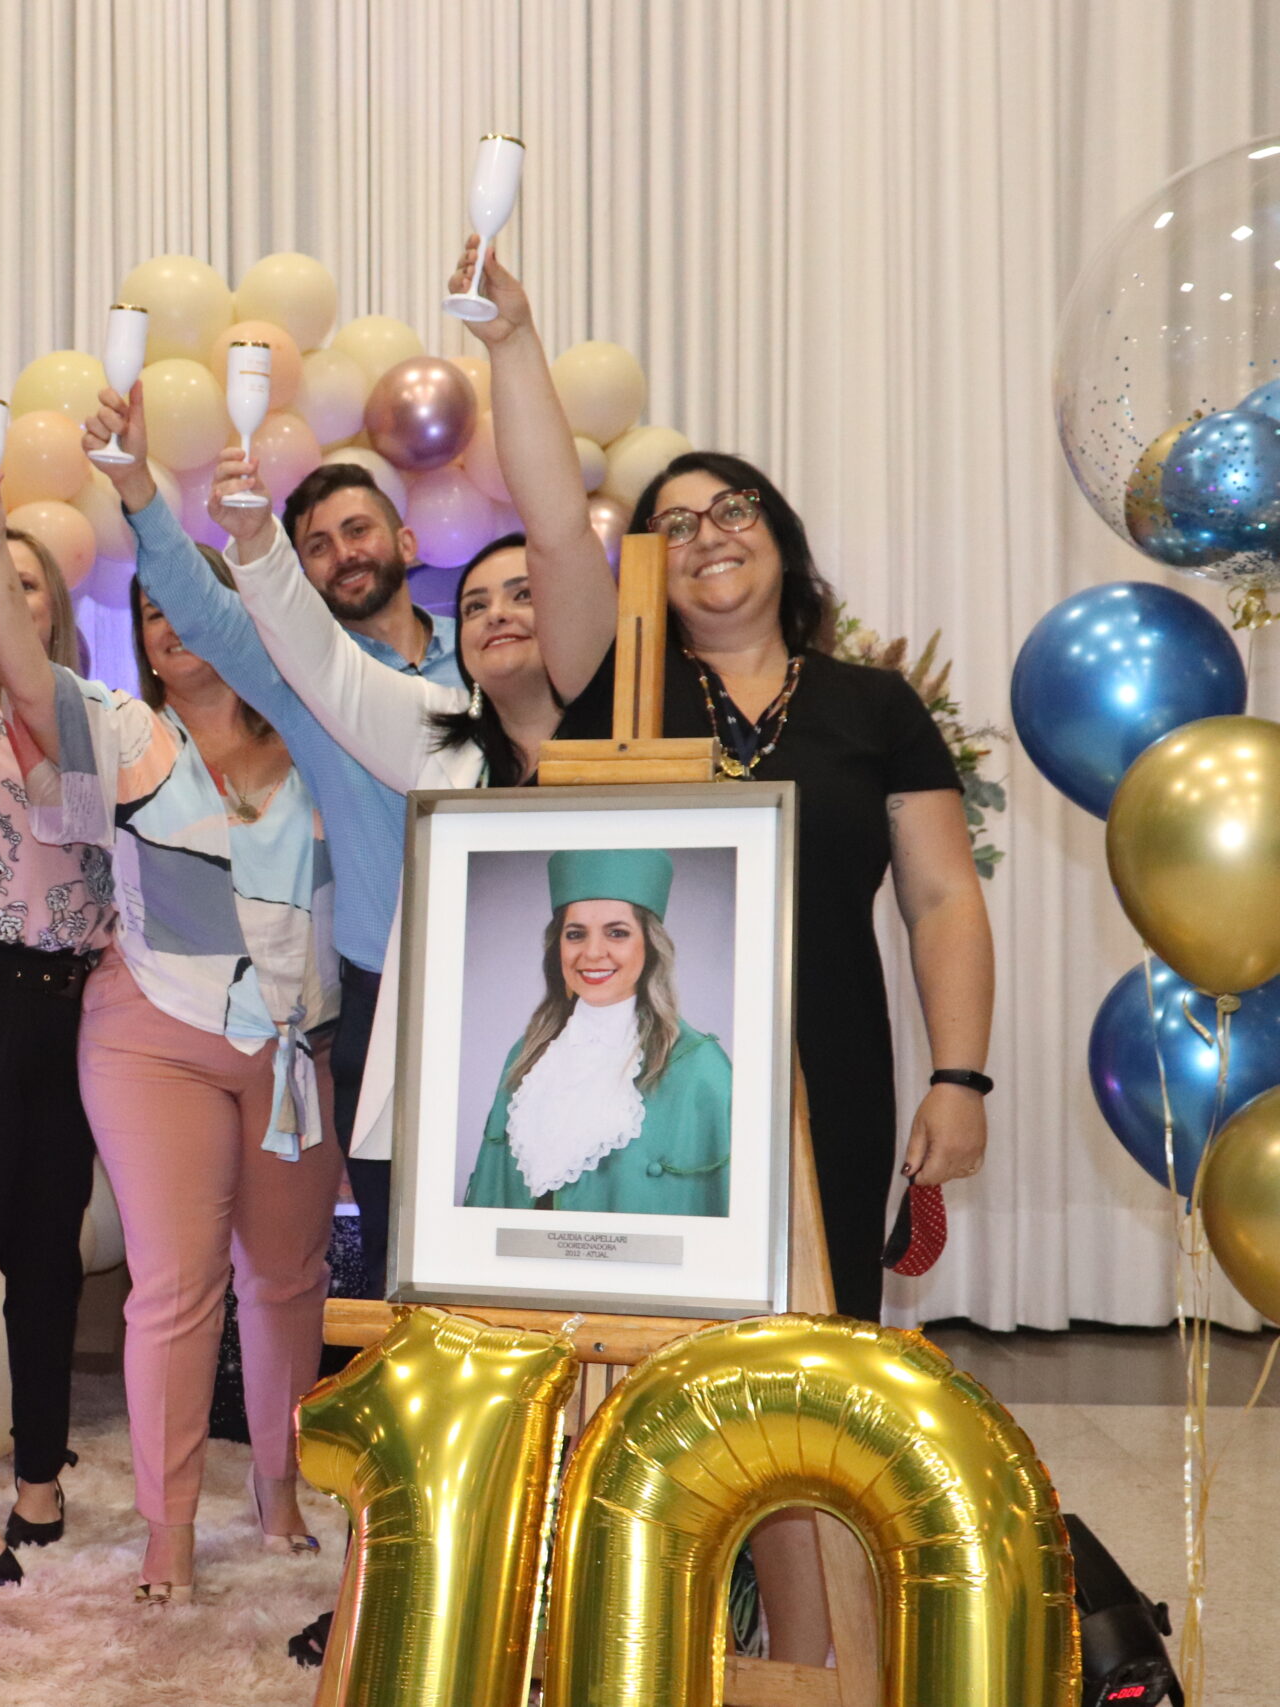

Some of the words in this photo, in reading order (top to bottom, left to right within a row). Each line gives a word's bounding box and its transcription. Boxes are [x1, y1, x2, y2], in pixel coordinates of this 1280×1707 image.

[547, 1232, 582, 1241] CLAUDIA
[584, 1234, 627, 1243] CAPELLARI
[557, 1241, 617, 1250] COORDENADORA
[585, 1250, 609, 1258] ATUAL
